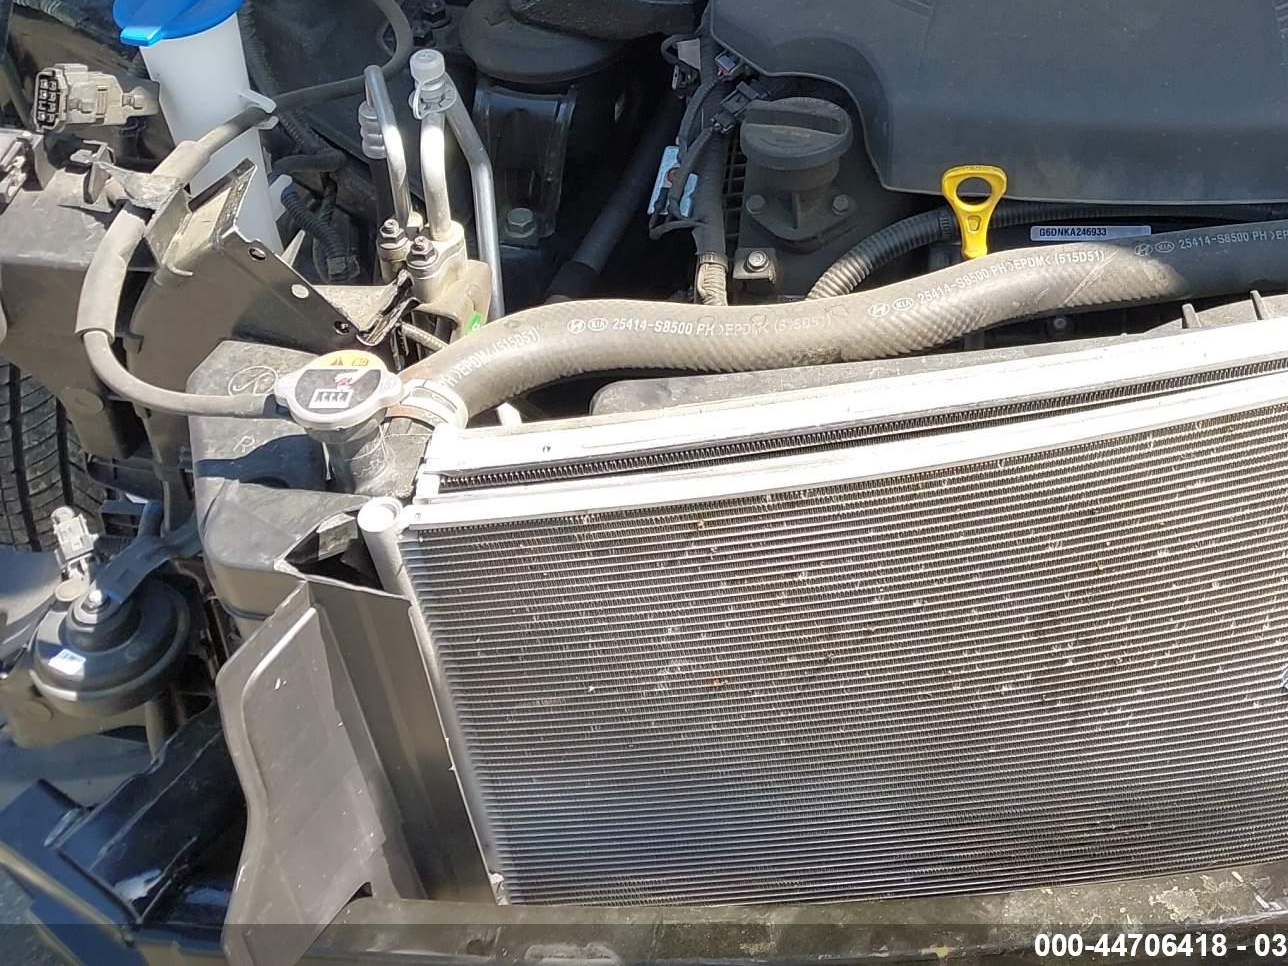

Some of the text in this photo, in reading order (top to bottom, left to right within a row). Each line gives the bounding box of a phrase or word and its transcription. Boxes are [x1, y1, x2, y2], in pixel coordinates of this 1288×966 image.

[1178, 232, 1249, 250] 25414-S8500
[1252, 229, 1267, 240] PH
[918, 266, 990, 306] 25414-S8500
[992, 262, 1006, 275] PH
[589, 319, 607, 331] KIA
[612, 318, 692, 335] 25414-S8500
